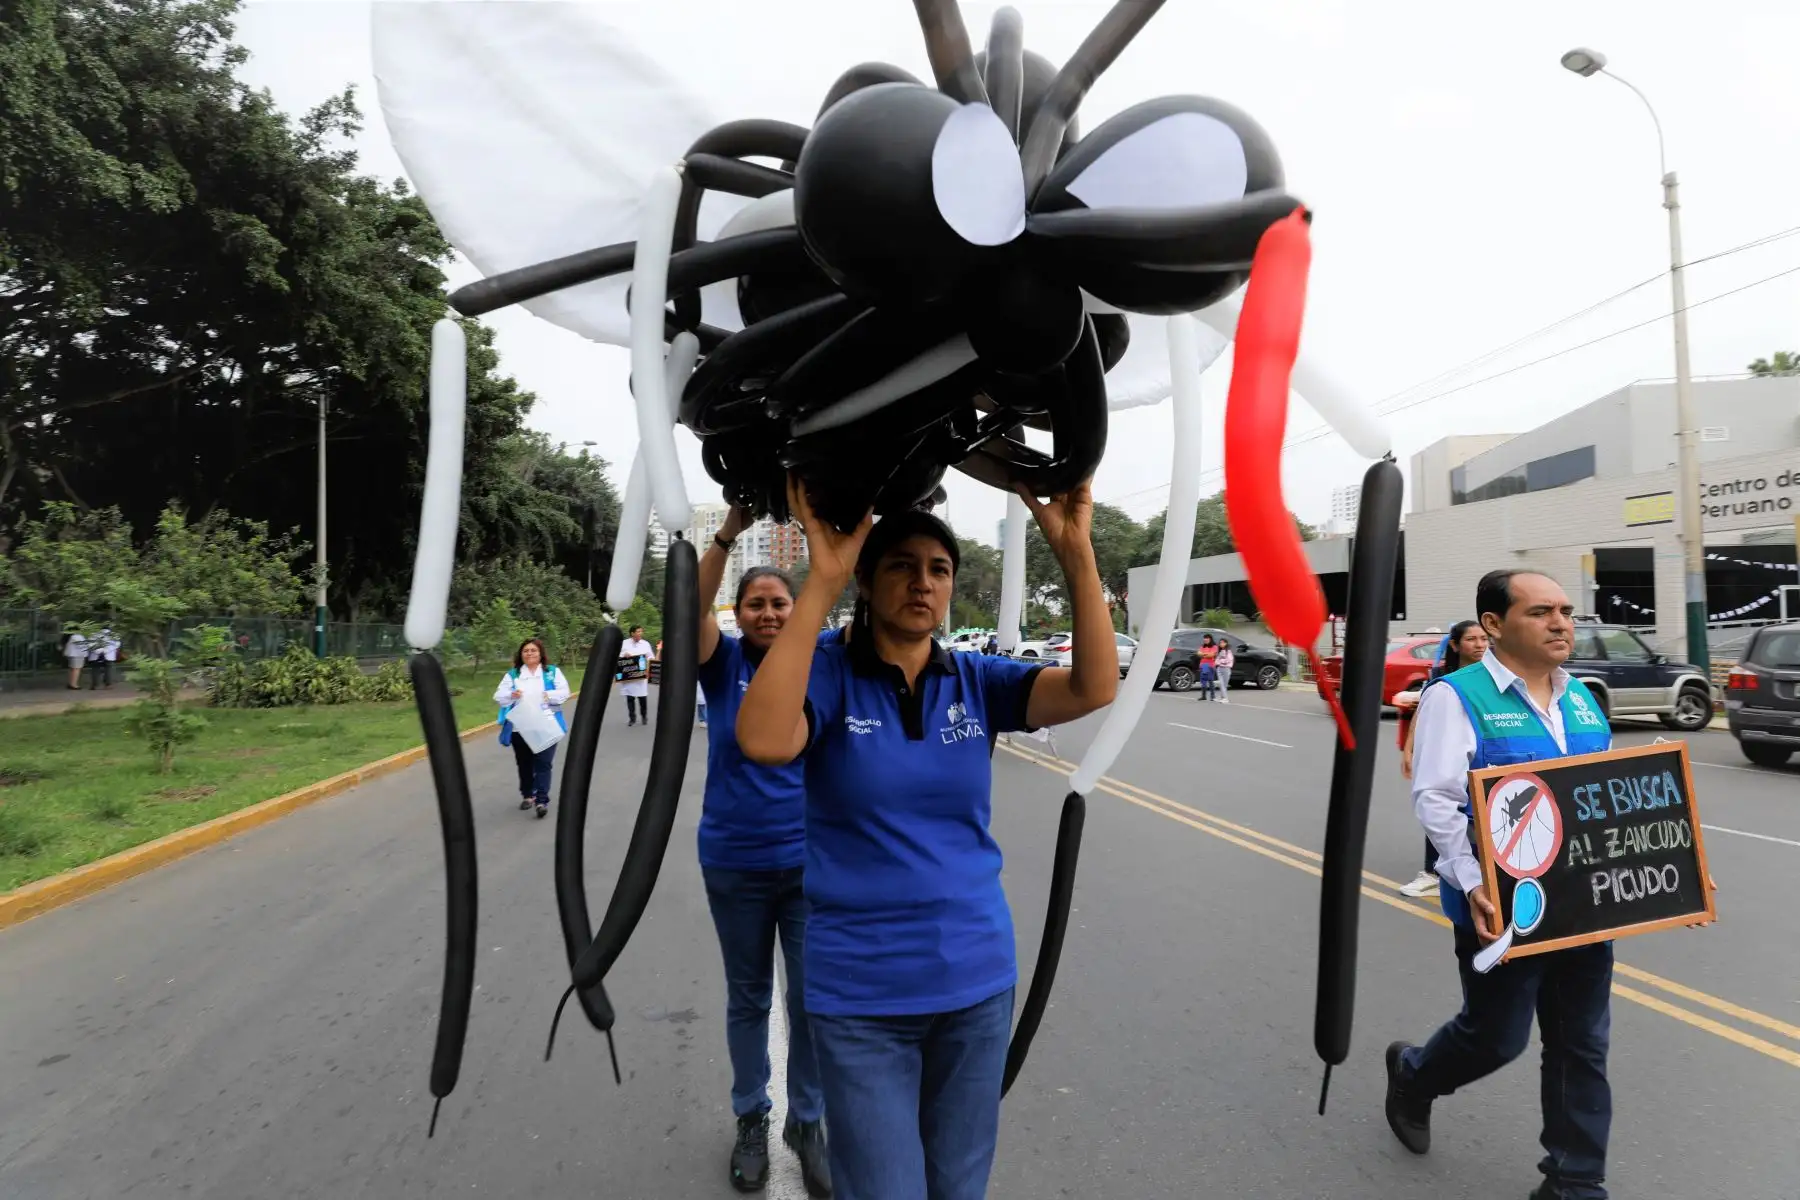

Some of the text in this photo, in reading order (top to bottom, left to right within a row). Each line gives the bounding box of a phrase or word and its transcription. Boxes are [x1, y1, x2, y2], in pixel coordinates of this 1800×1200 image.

[848, 724, 873, 734] SOCIAL
[1484, 712, 1529, 721] DESARROLLO
[941, 724, 985, 744] LIMA
[1573, 770, 1682, 821] SE BUSCA
[1567, 818, 1692, 867] AL ZANCUDO
[1591, 863, 1680, 906] PICUDO
